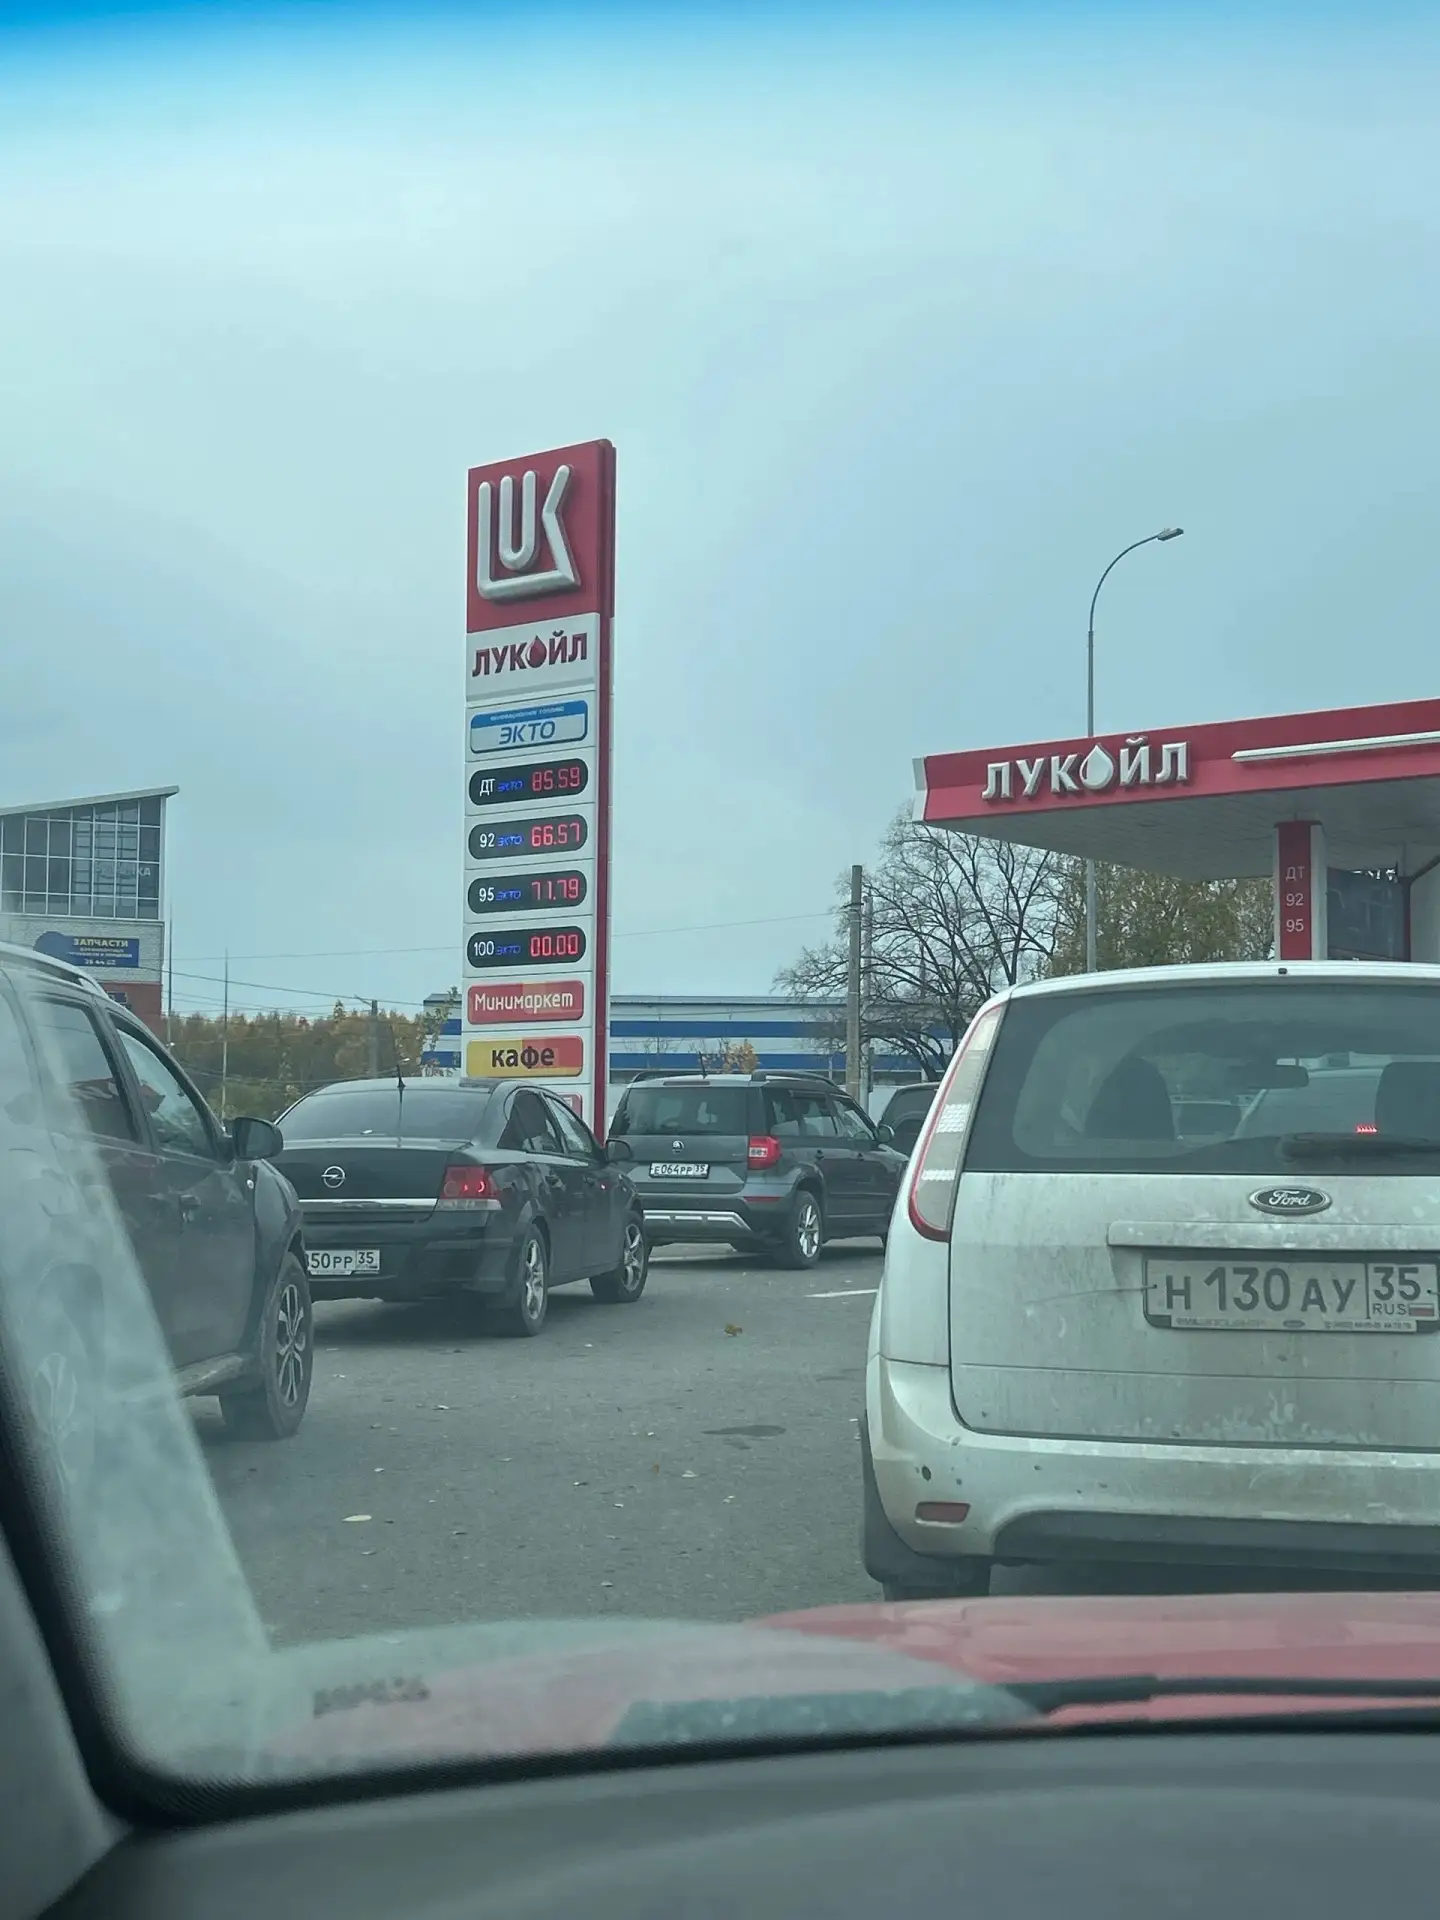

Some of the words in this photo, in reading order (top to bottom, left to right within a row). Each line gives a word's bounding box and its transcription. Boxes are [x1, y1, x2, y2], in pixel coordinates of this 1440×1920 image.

[472, 630, 587, 677] ЛУКОЙЛ
[499, 721, 555, 744] ЭКТО
[982, 735, 1189, 801] ЛУКОЙЛ
[480, 778, 495, 797] ДТ
[532, 767, 580, 792] 85.59
[480, 833, 495, 848] 92
[531, 822, 580, 847] 66.57
[1285, 866, 1305, 881] ДТ
[479, 888, 494, 902] 95
[531, 878, 579, 901] 71.79
[1286, 893, 1304, 906] 92
[1286, 919, 1304, 932] 95
[73, 938, 128, 947] ЗАПЧАСТИ
[474, 940, 494, 956] 100
[530, 934, 578, 957] 00.00
[474, 992, 573, 1014] Минимаркет
[491, 1046, 555, 1069] кафе
[1268, 1190, 1311, 1207] Ford
[358, 1252, 374, 1264] 35
[1373, 1266, 1421, 1301] 35
[1373, 1303, 1407, 1316] RUS
